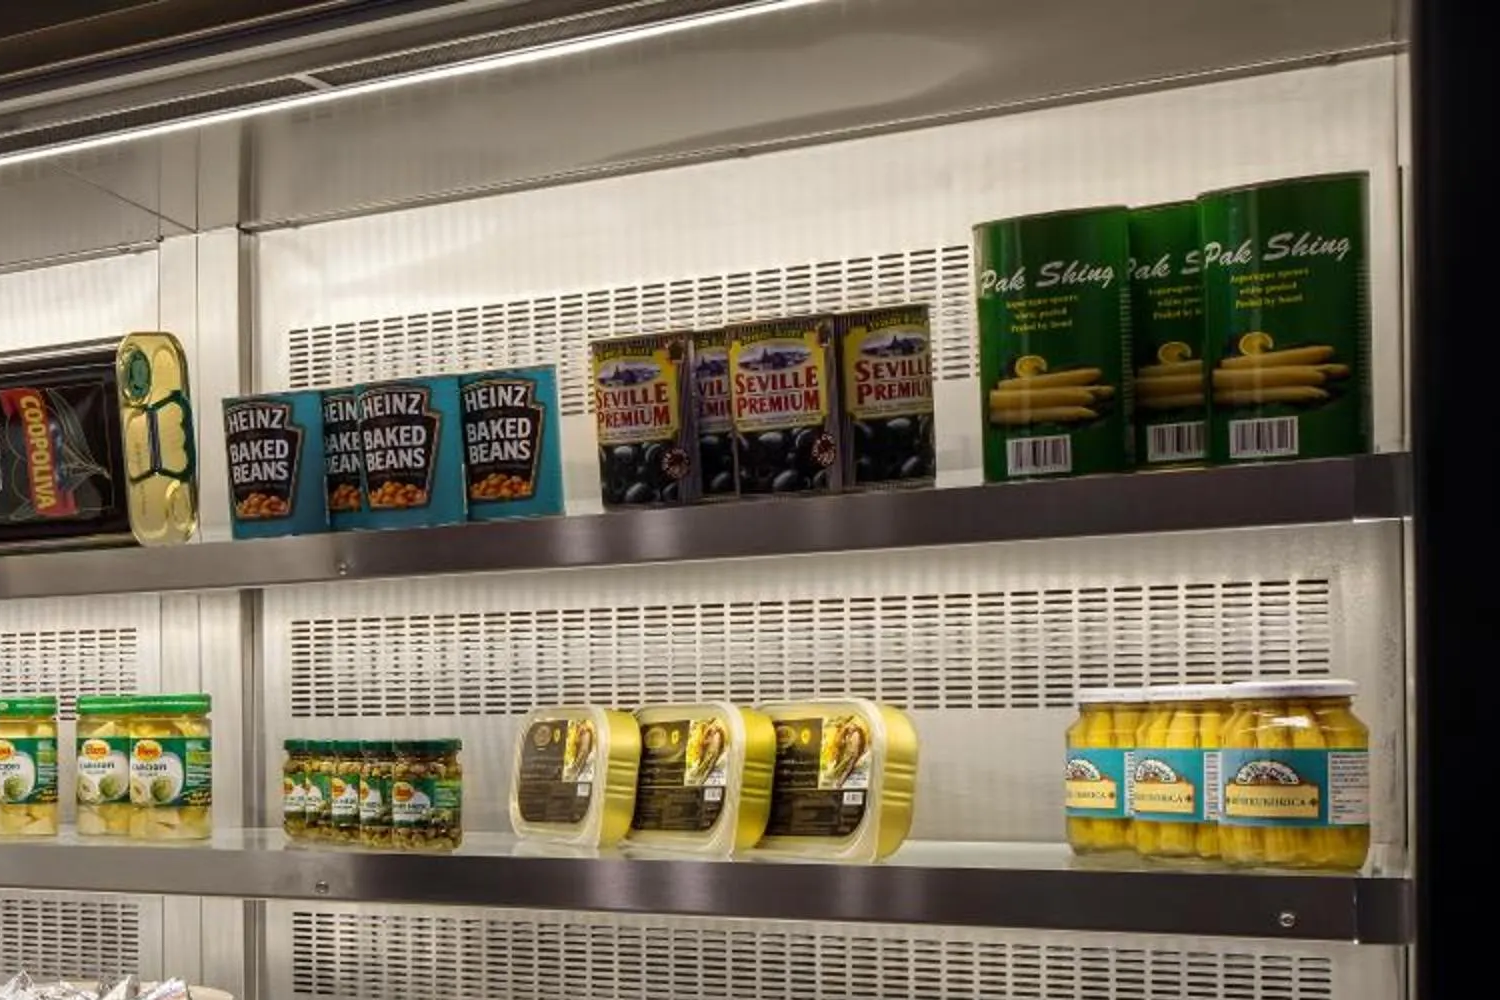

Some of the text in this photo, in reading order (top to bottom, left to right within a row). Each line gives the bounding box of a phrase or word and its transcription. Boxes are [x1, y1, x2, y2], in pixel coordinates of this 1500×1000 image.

[1204, 238, 1253, 269] Pak
[1263, 231, 1350, 262] Shing
[980, 260, 1115, 295] Pak Shing
[735, 366, 818, 395] SEVILLE
[361, 393, 421, 420] HEINZ
[465, 385, 527, 413] HEINZ
[595, 382, 669, 411] SEVILLE
[737, 390, 820, 418] PREMIUM
[228, 408, 283, 434] HEINZ
[325, 400, 359, 423] EIN
[597, 405, 671, 429] PREMIUM
[324, 431, 360, 454] AKE
[363, 425, 427, 451] BAKED
[466, 417, 531, 443] BAKED
[19, 395, 57, 509] COOPOLIVA
[230, 439, 289, 463] BAKED
[325, 453, 361, 475] EAN
[366, 448, 425, 473] BEANS
[468, 440, 531, 465] BEANS
[232, 461, 289, 484] BEANS
